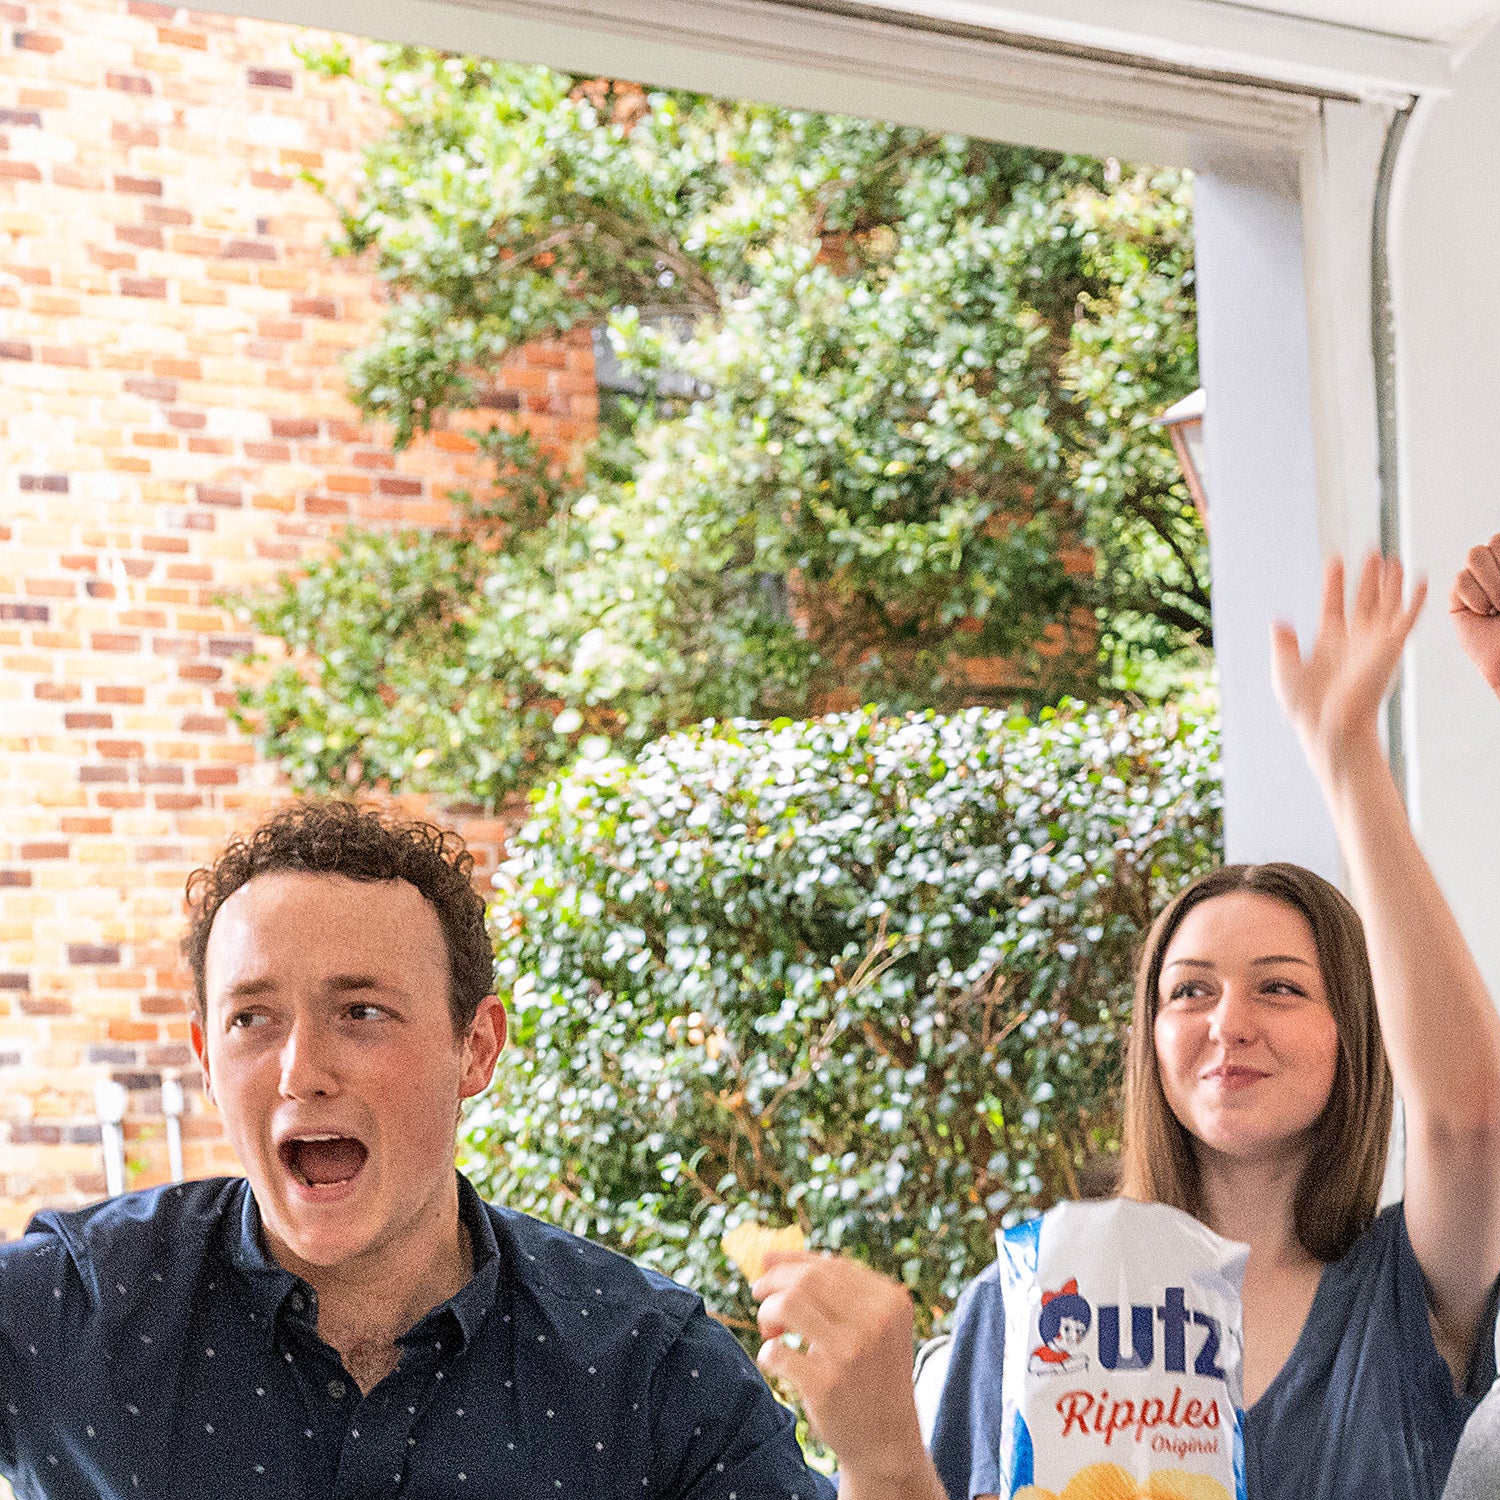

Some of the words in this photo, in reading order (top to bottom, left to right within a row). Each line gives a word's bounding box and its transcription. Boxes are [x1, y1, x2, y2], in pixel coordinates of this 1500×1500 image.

[1097, 1286, 1227, 1380] utz
[1055, 1386, 1220, 1447] Ripples
[1151, 1433, 1219, 1460] Original
